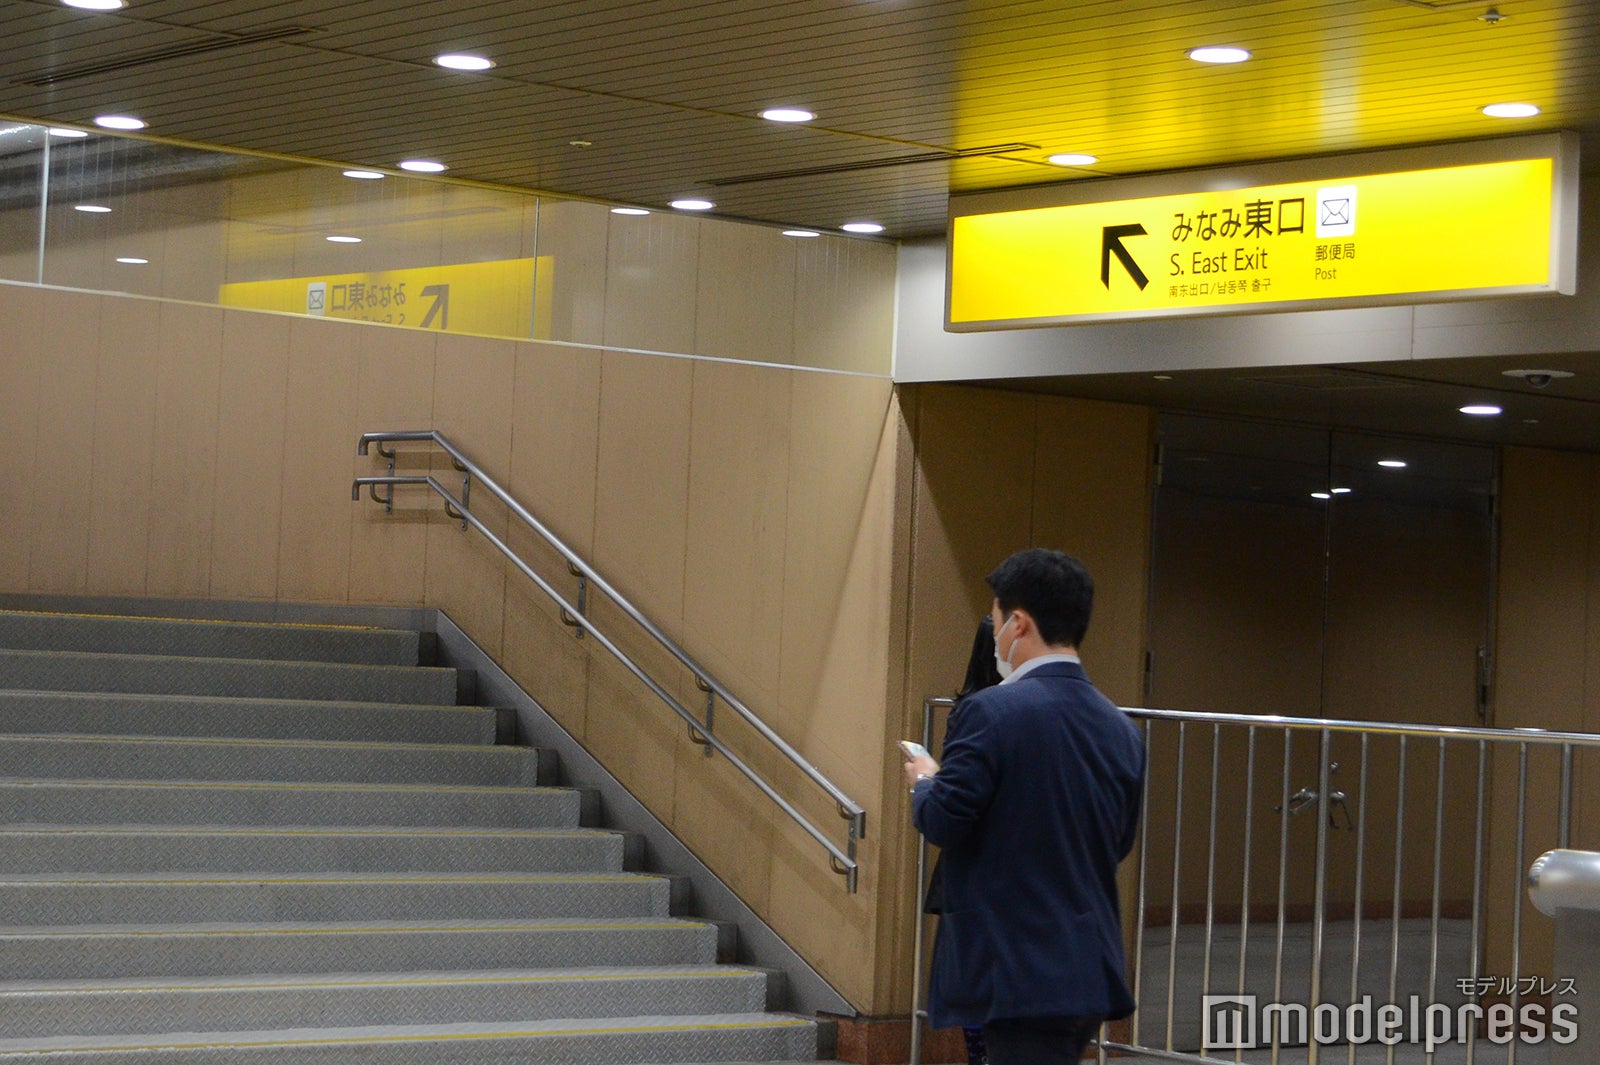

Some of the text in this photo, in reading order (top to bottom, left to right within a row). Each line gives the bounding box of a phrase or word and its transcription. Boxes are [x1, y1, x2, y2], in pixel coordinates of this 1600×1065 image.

[1172, 198, 1305, 242] みなみ東口
[1170, 247, 1268, 276] S. East Exit
[1315, 243, 1355, 261] 郵便局
[1315, 267, 1337, 280] Post
